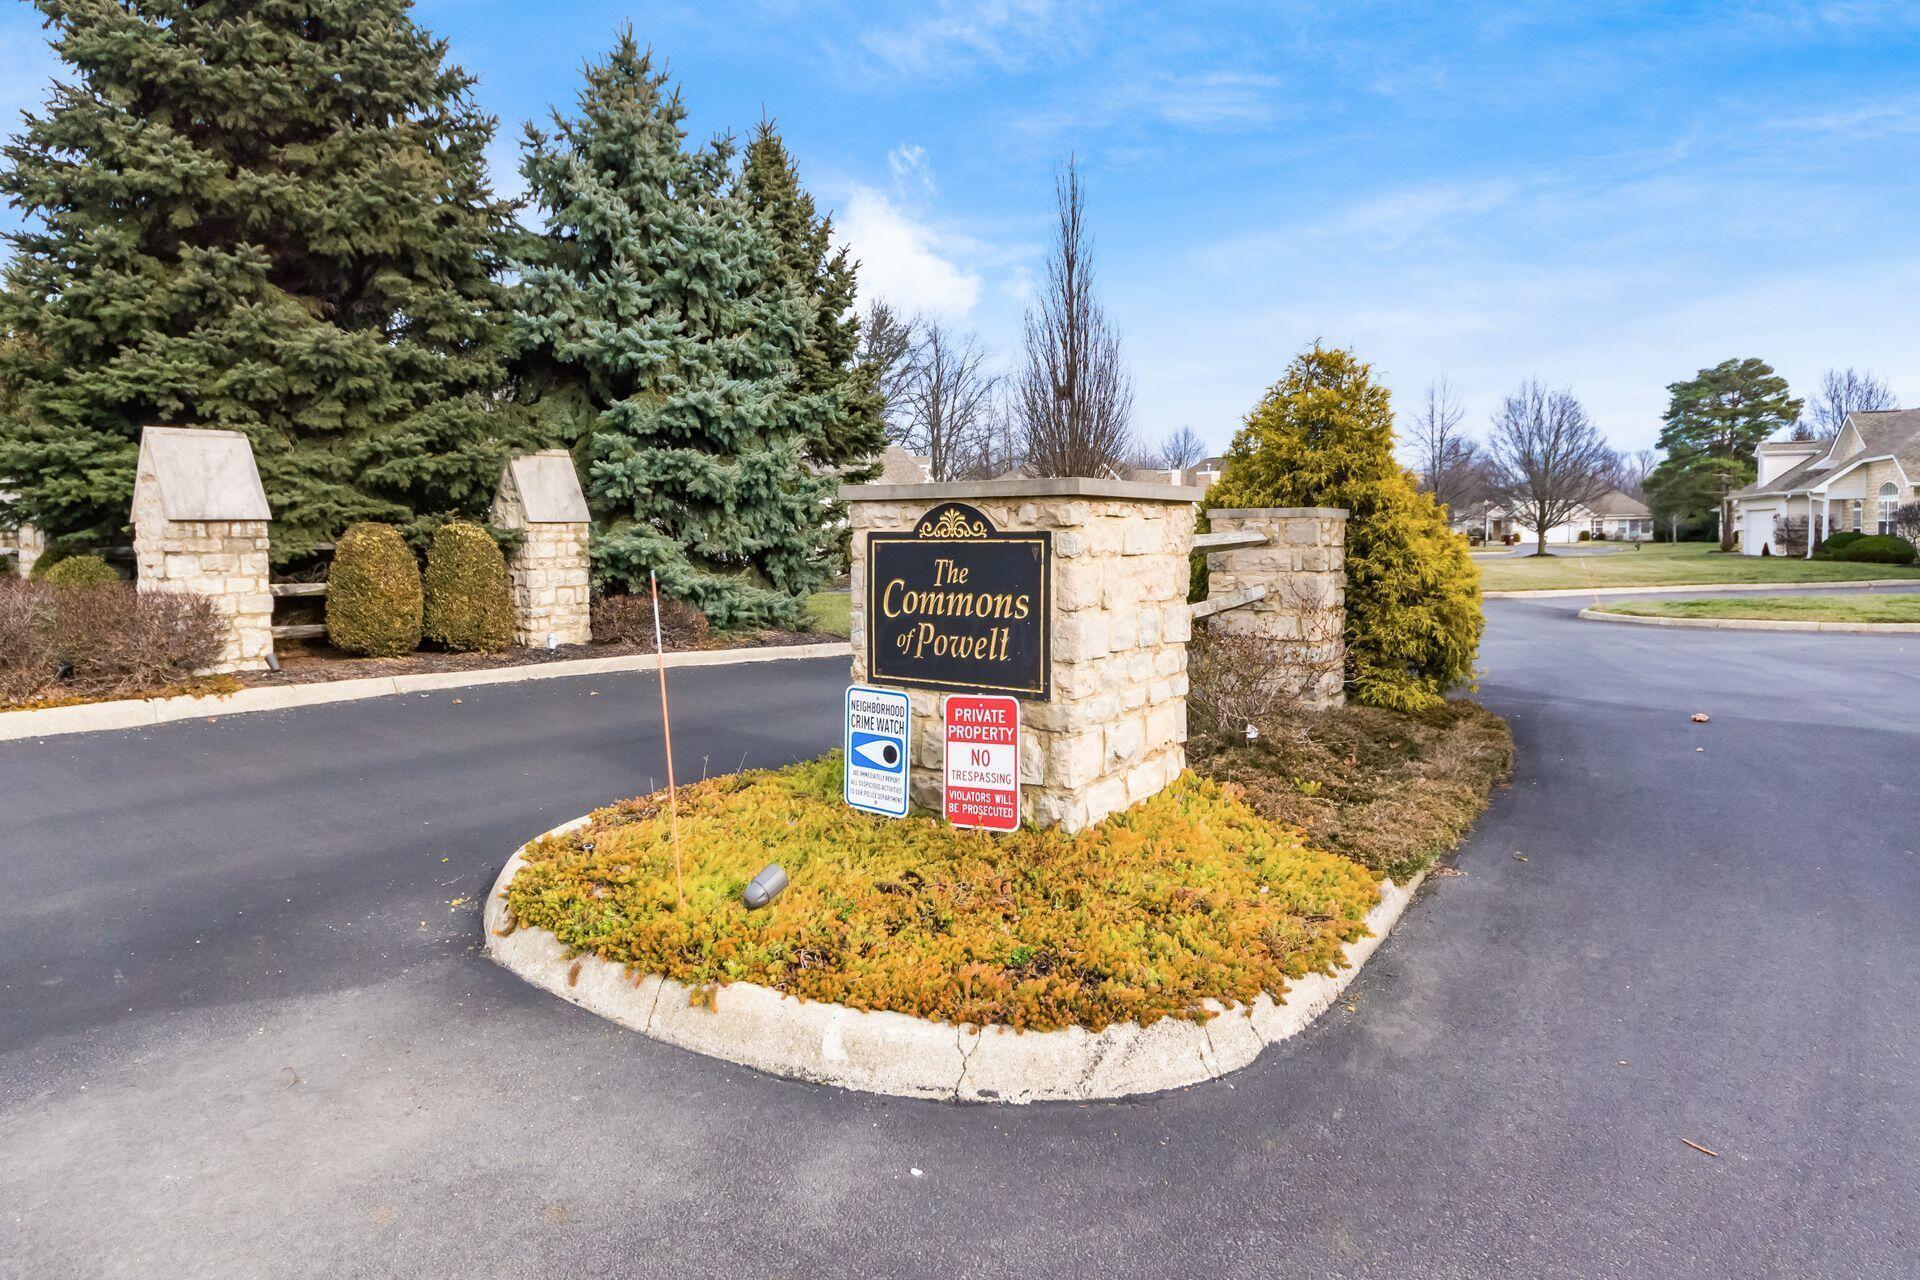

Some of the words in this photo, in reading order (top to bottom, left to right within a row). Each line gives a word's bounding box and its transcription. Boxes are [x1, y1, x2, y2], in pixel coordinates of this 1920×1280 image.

[933, 558, 969, 587] The
[883, 577, 1030, 620] Commons
[896, 628, 916, 655] of
[913, 622, 1010, 661] Powell
[851, 700, 905, 717] NEIGHBORHOOD
[955, 708, 1006, 724] PRIVATE
[851, 713, 875, 731] CRIME
[876, 717, 905, 735] WATCH
[948, 725, 1014, 741] PROPERTY
[971, 749, 990, 767] NO
[951, 769, 1012, 785] TRESPASSING
[949, 790, 991, 803] VIOLATORS
[995, 793, 1013, 805] WILL
[949, 803, 959, 813] BE
[962, 804, 1013, 818] PROSECUTED
